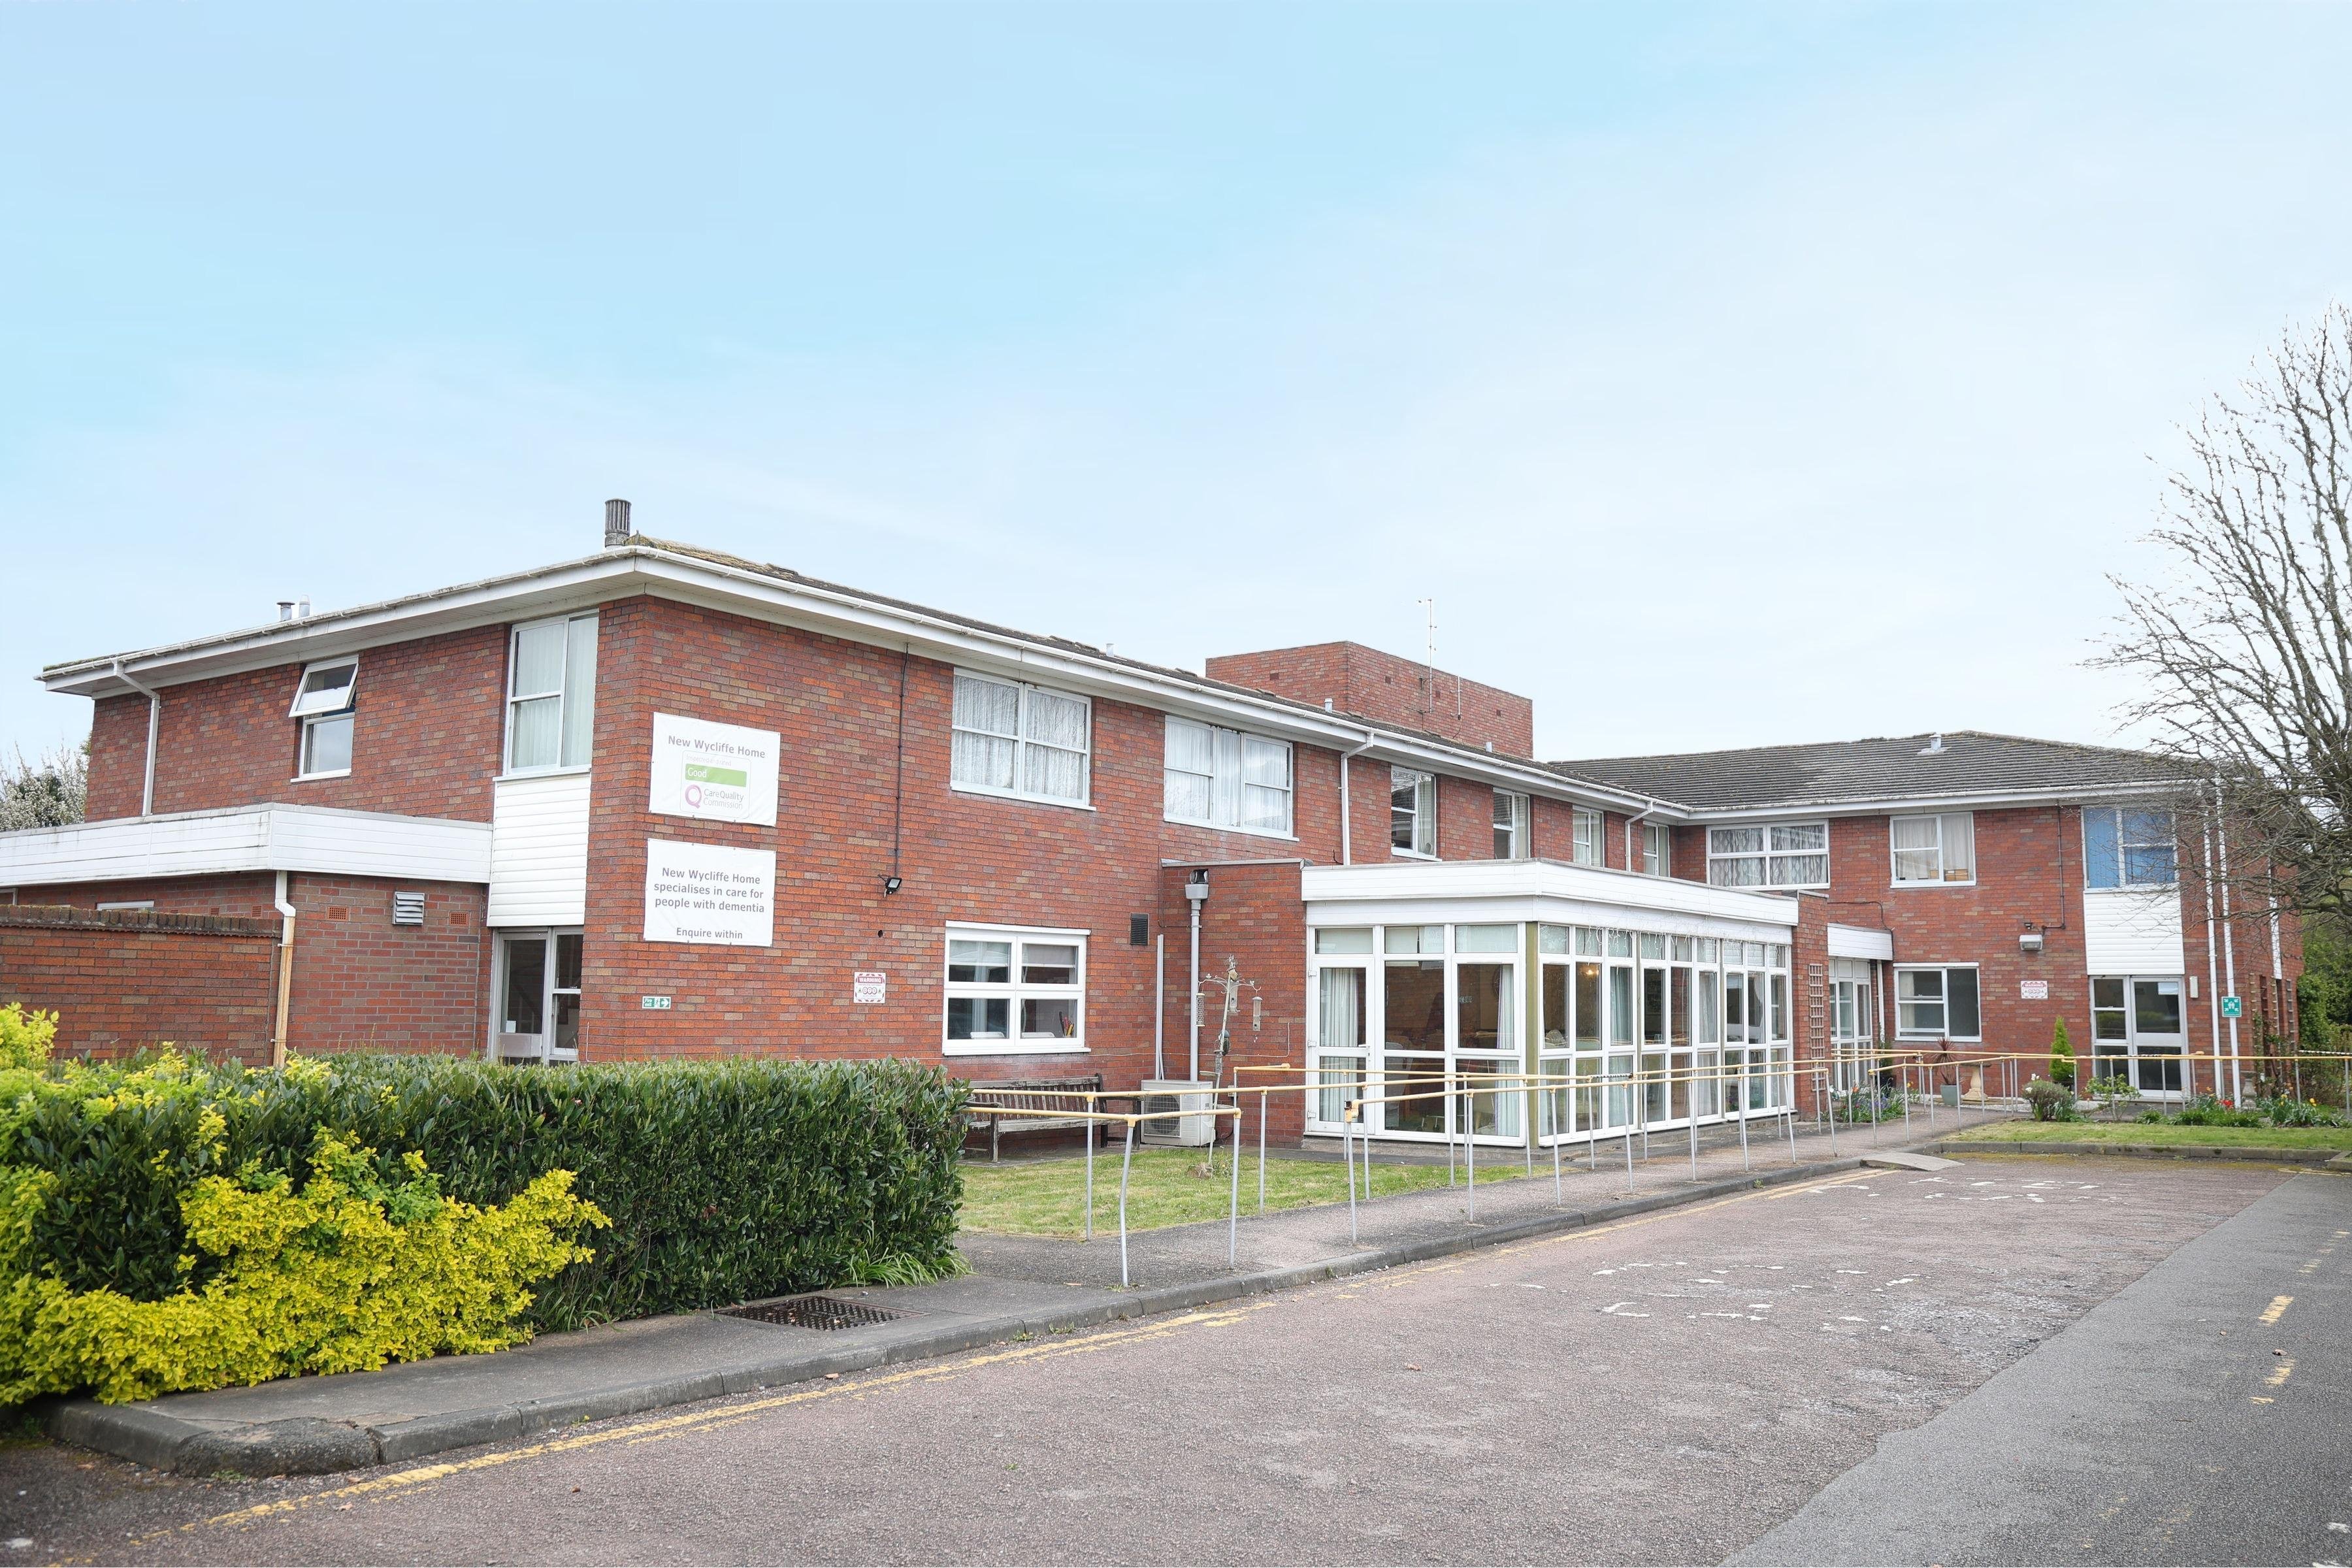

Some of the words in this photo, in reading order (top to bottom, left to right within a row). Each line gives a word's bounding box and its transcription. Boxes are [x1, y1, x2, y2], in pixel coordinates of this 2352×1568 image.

[668, 735, 691, 747] New
[694, 739, 734, 753] Wycliffe
[738, 746, 766, 758] Home
[687, 767, 707, 778] Good
[703, 797, 743, 809] Commission
[704, 789, 719, 798] Care
[719, 791, 744, 803] Quality
[662, 867, 685, 878] New
[689, 870, 729, 882] Wycliffe
[732, 874, 760, 884] Home
[654, 883, 710, 895] specialises
[713, 886, 723, 896] in
[750, 889, 764, 899] for
[655, 898, 690, 909] people
[693, 900, 715, 910] with
[719, 901, 764, 913] dementia
[676, 927, 711, 938] Enquire
[715, 930, 743, 939] within
